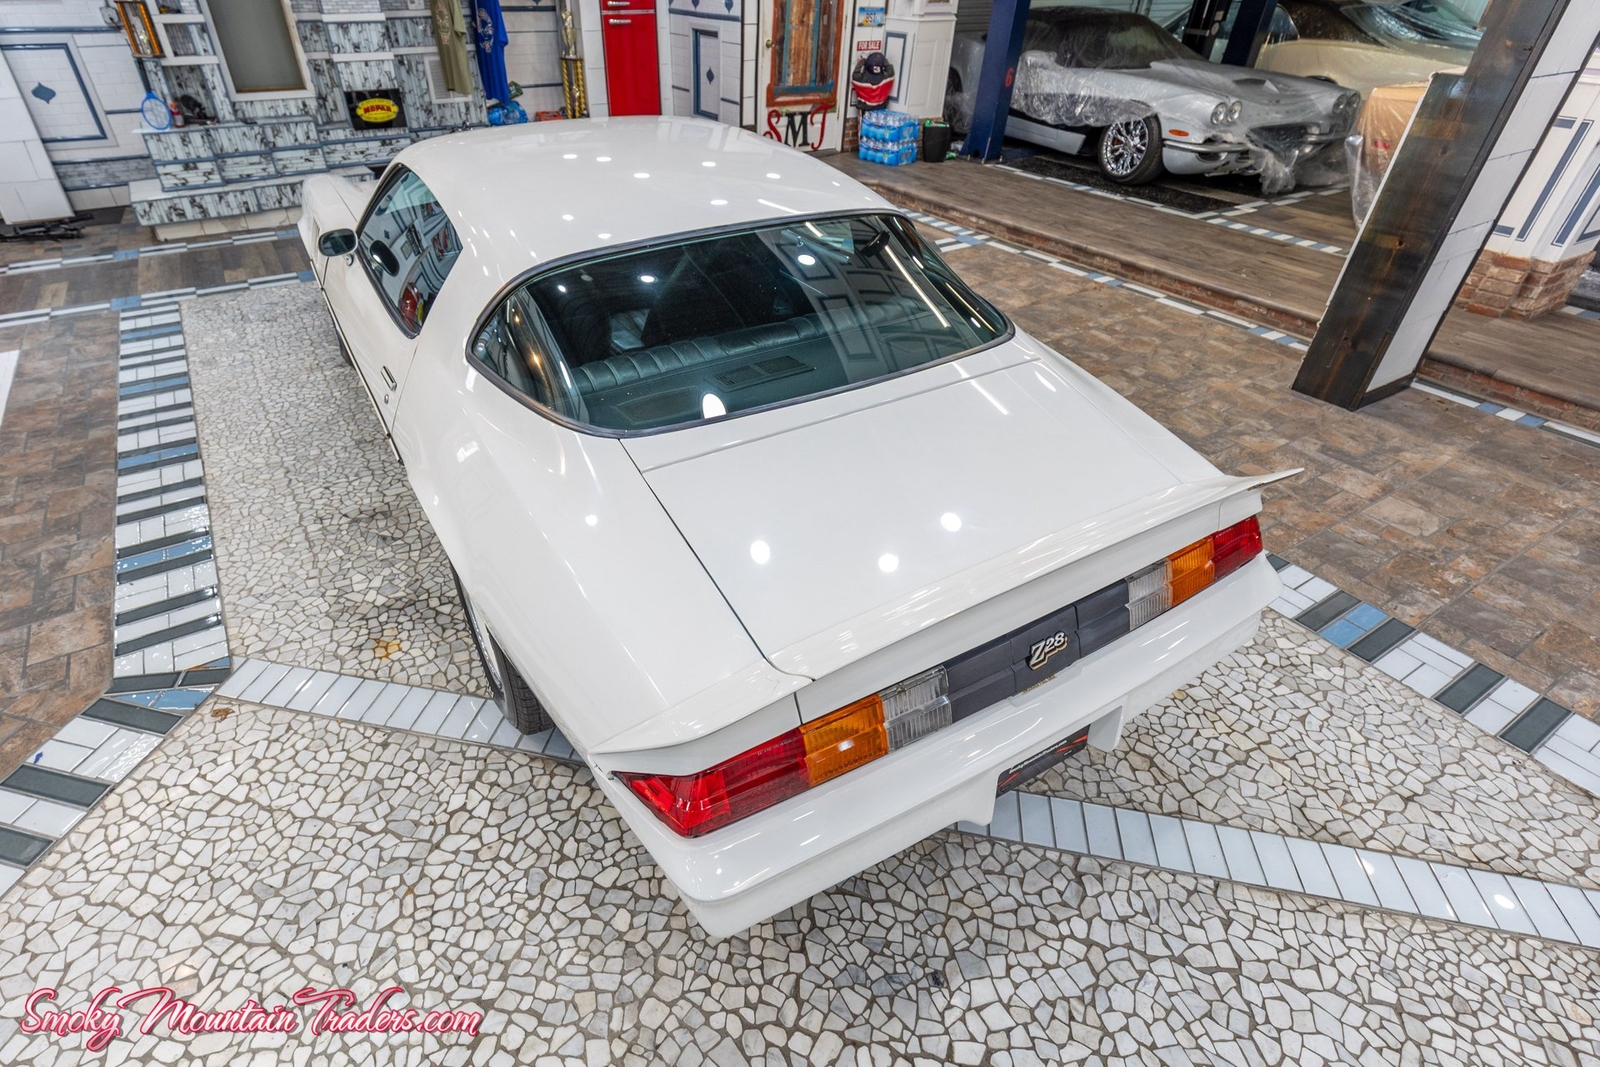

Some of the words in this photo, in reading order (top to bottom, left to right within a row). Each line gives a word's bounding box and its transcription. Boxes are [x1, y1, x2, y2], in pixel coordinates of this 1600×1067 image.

[858, 41, 868, 50] FOR
[868, 40, 880, 50] SALE
[1004, 67, 1014, 87] 6
[1029, 631, 1067, 670] Z28
